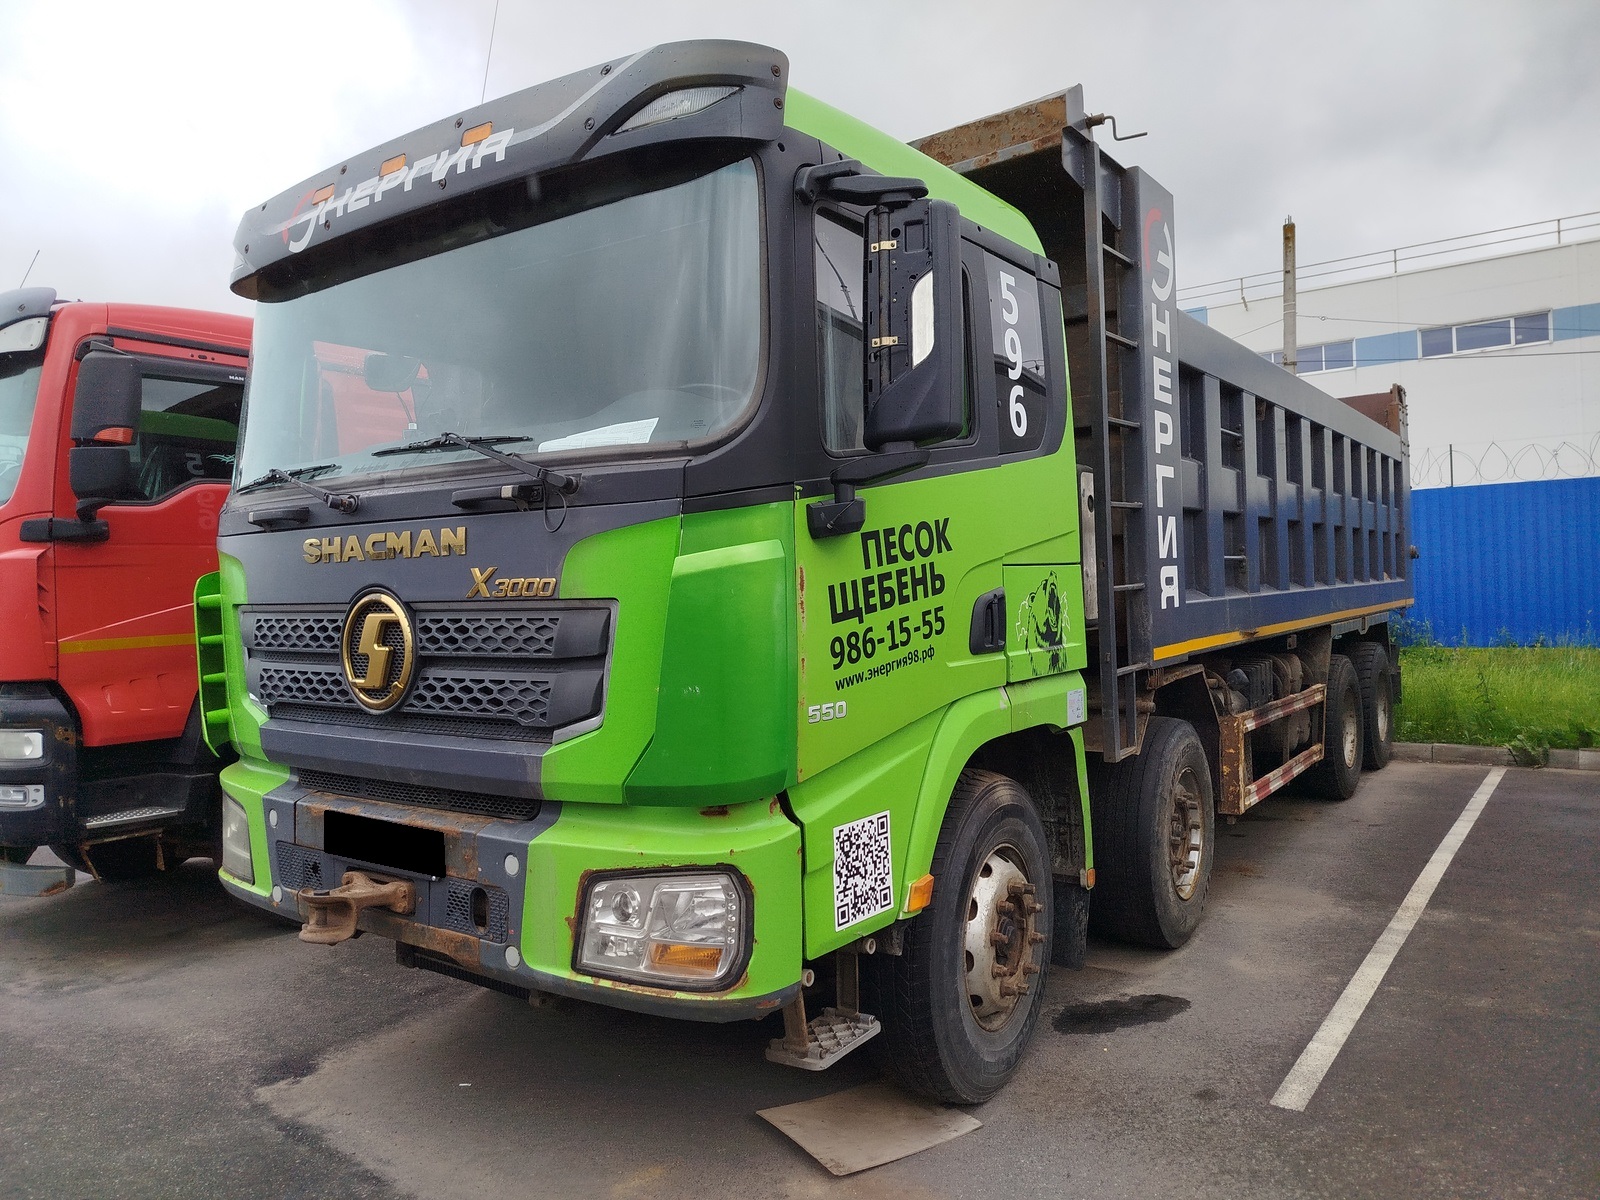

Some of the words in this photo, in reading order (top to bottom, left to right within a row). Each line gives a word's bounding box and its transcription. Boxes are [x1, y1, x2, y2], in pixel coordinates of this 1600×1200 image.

[1000, 271, 1028, 437] 596
[1150, 221, 1180, 610] ЭНЕРГИЯ
[303, 526, 468, 564] SHACMAN
[860, 517, 953, 570] ПЕСОК
[827, 561, 946, 625] ЩЕБЕНЬ
[829, 605, 946, 671] 986-15-55
[835, 644, 935, 691] www.энергия98.рф
[808, 700, 848, 724] 550
